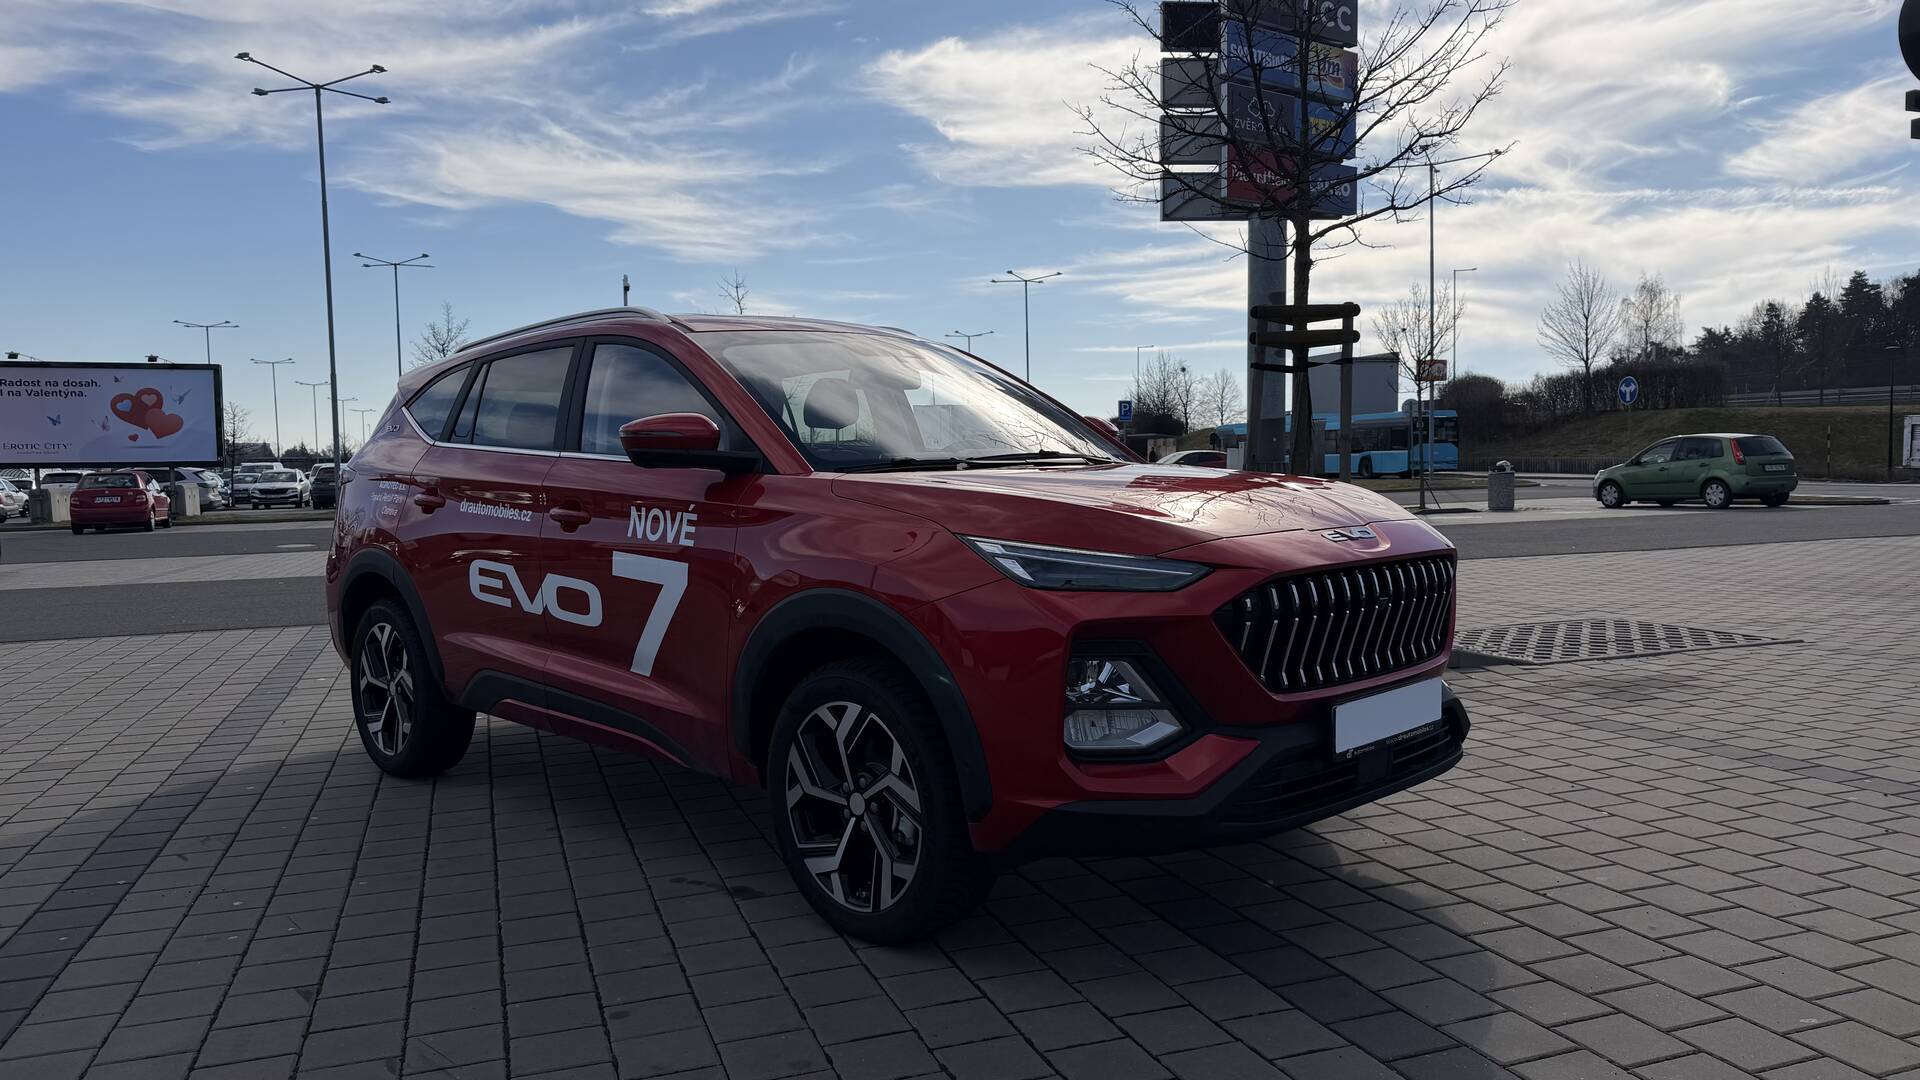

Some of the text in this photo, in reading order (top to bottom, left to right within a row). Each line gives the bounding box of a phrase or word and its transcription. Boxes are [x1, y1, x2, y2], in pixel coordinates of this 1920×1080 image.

[1304, 0, 1352, 32] CC
[0, 379, 101, 388] Radost na dosah.
[25, 388, 88, 399] Valentýna.
[1121, 403, 1129, 415] P
[460, 498, 533, 522] drautomobiles.cz
[626, 503, 698, 547] NOVÉ
[469, 550, 689, 678] EVO 7
